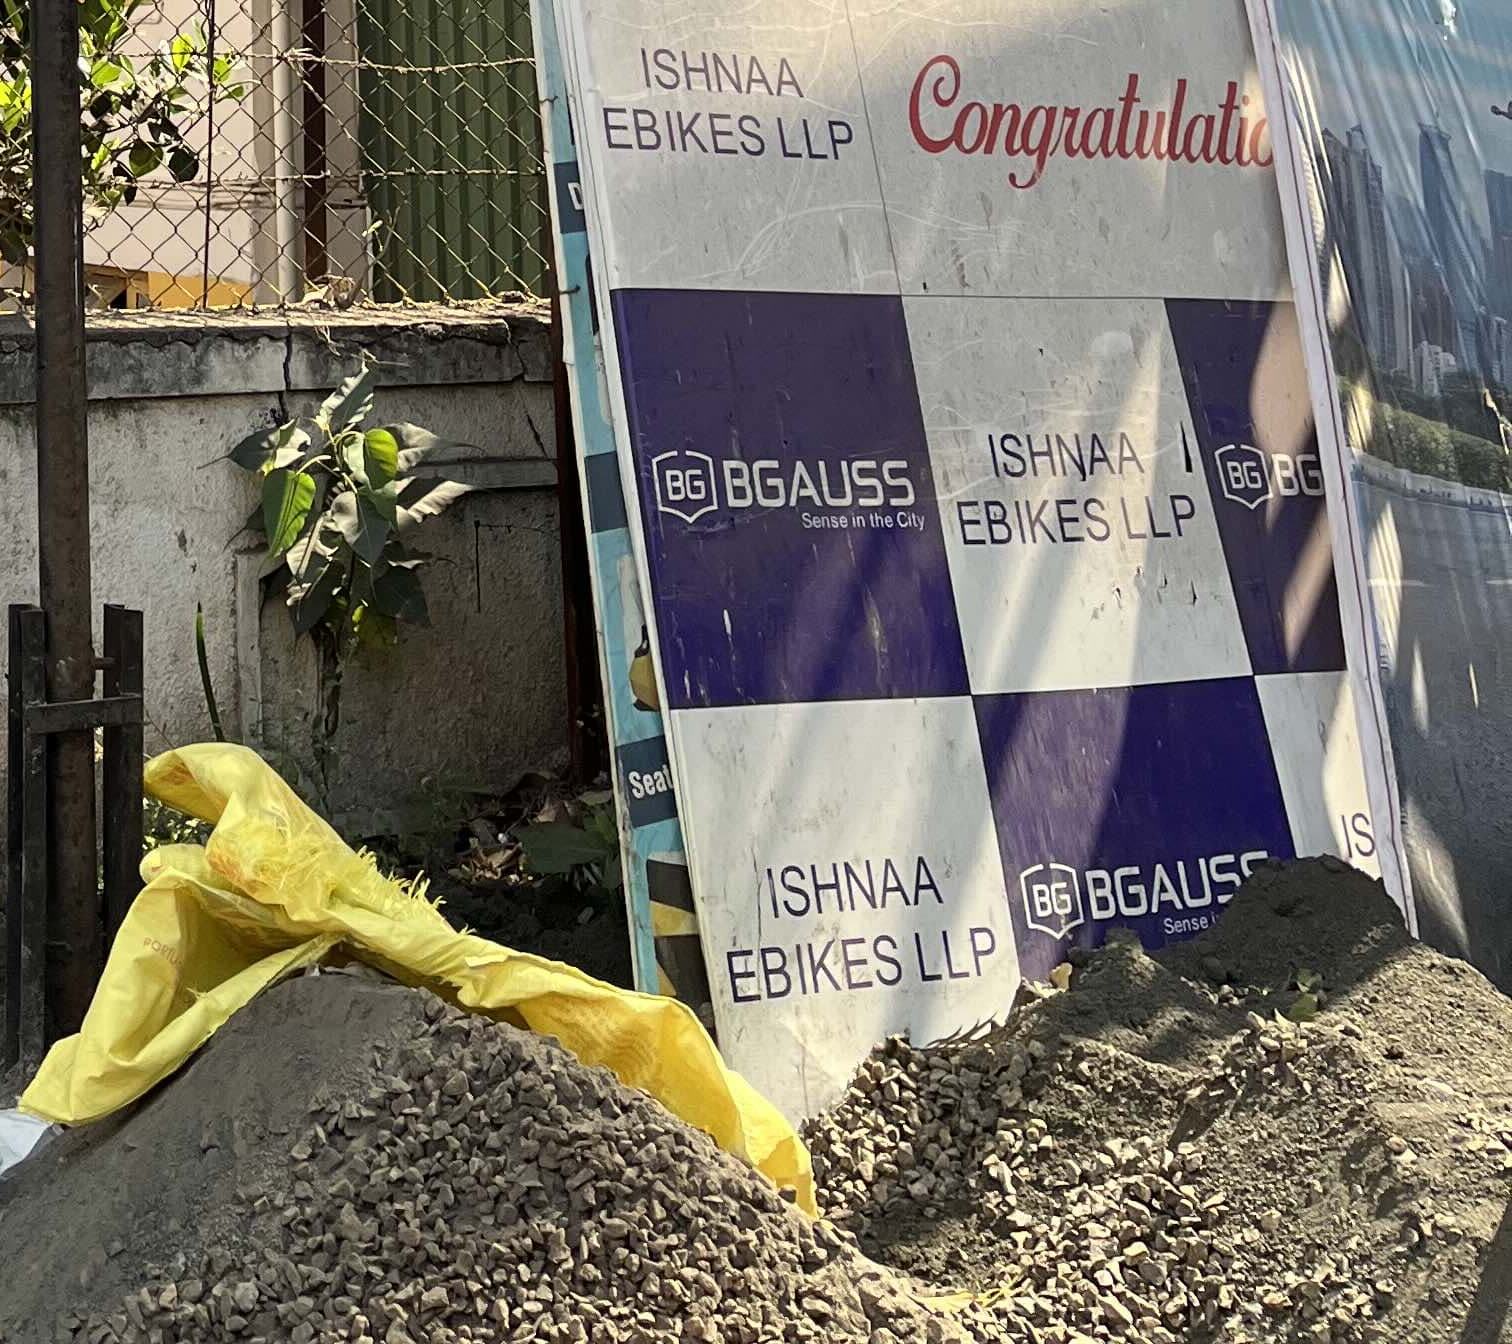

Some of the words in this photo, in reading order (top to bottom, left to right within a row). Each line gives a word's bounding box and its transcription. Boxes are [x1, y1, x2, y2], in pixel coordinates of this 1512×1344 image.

[639, 46, 805, 101] ISHNAA
[602, 105, 767, 159] EBIKES
[778, 116, 854, 162] LLP
[990, 431, 1145, 483] ISHNAA
[1226, 461, 1263, 491] BG
[664, 468, 707, 502] BG
[726, 458, 916, 510] BGAUSS
[801, 511, 848, 531] Sense
[851, 511, 864, 530] in
[869, 511, 893, 530] the
[897, 511, 926, 534] City
[958, 497, 1111, 546] EBIKES
[1126, 493, 1196, 541] LLP
[766, 855, 944, 920] ISHNAA
[1031, 882, 1073, 918] BG
[1163, 913, 1210, 937] Sense
[727, 934, 901, 1003] EBIKES
[914, 926, 997, 984] LLP
